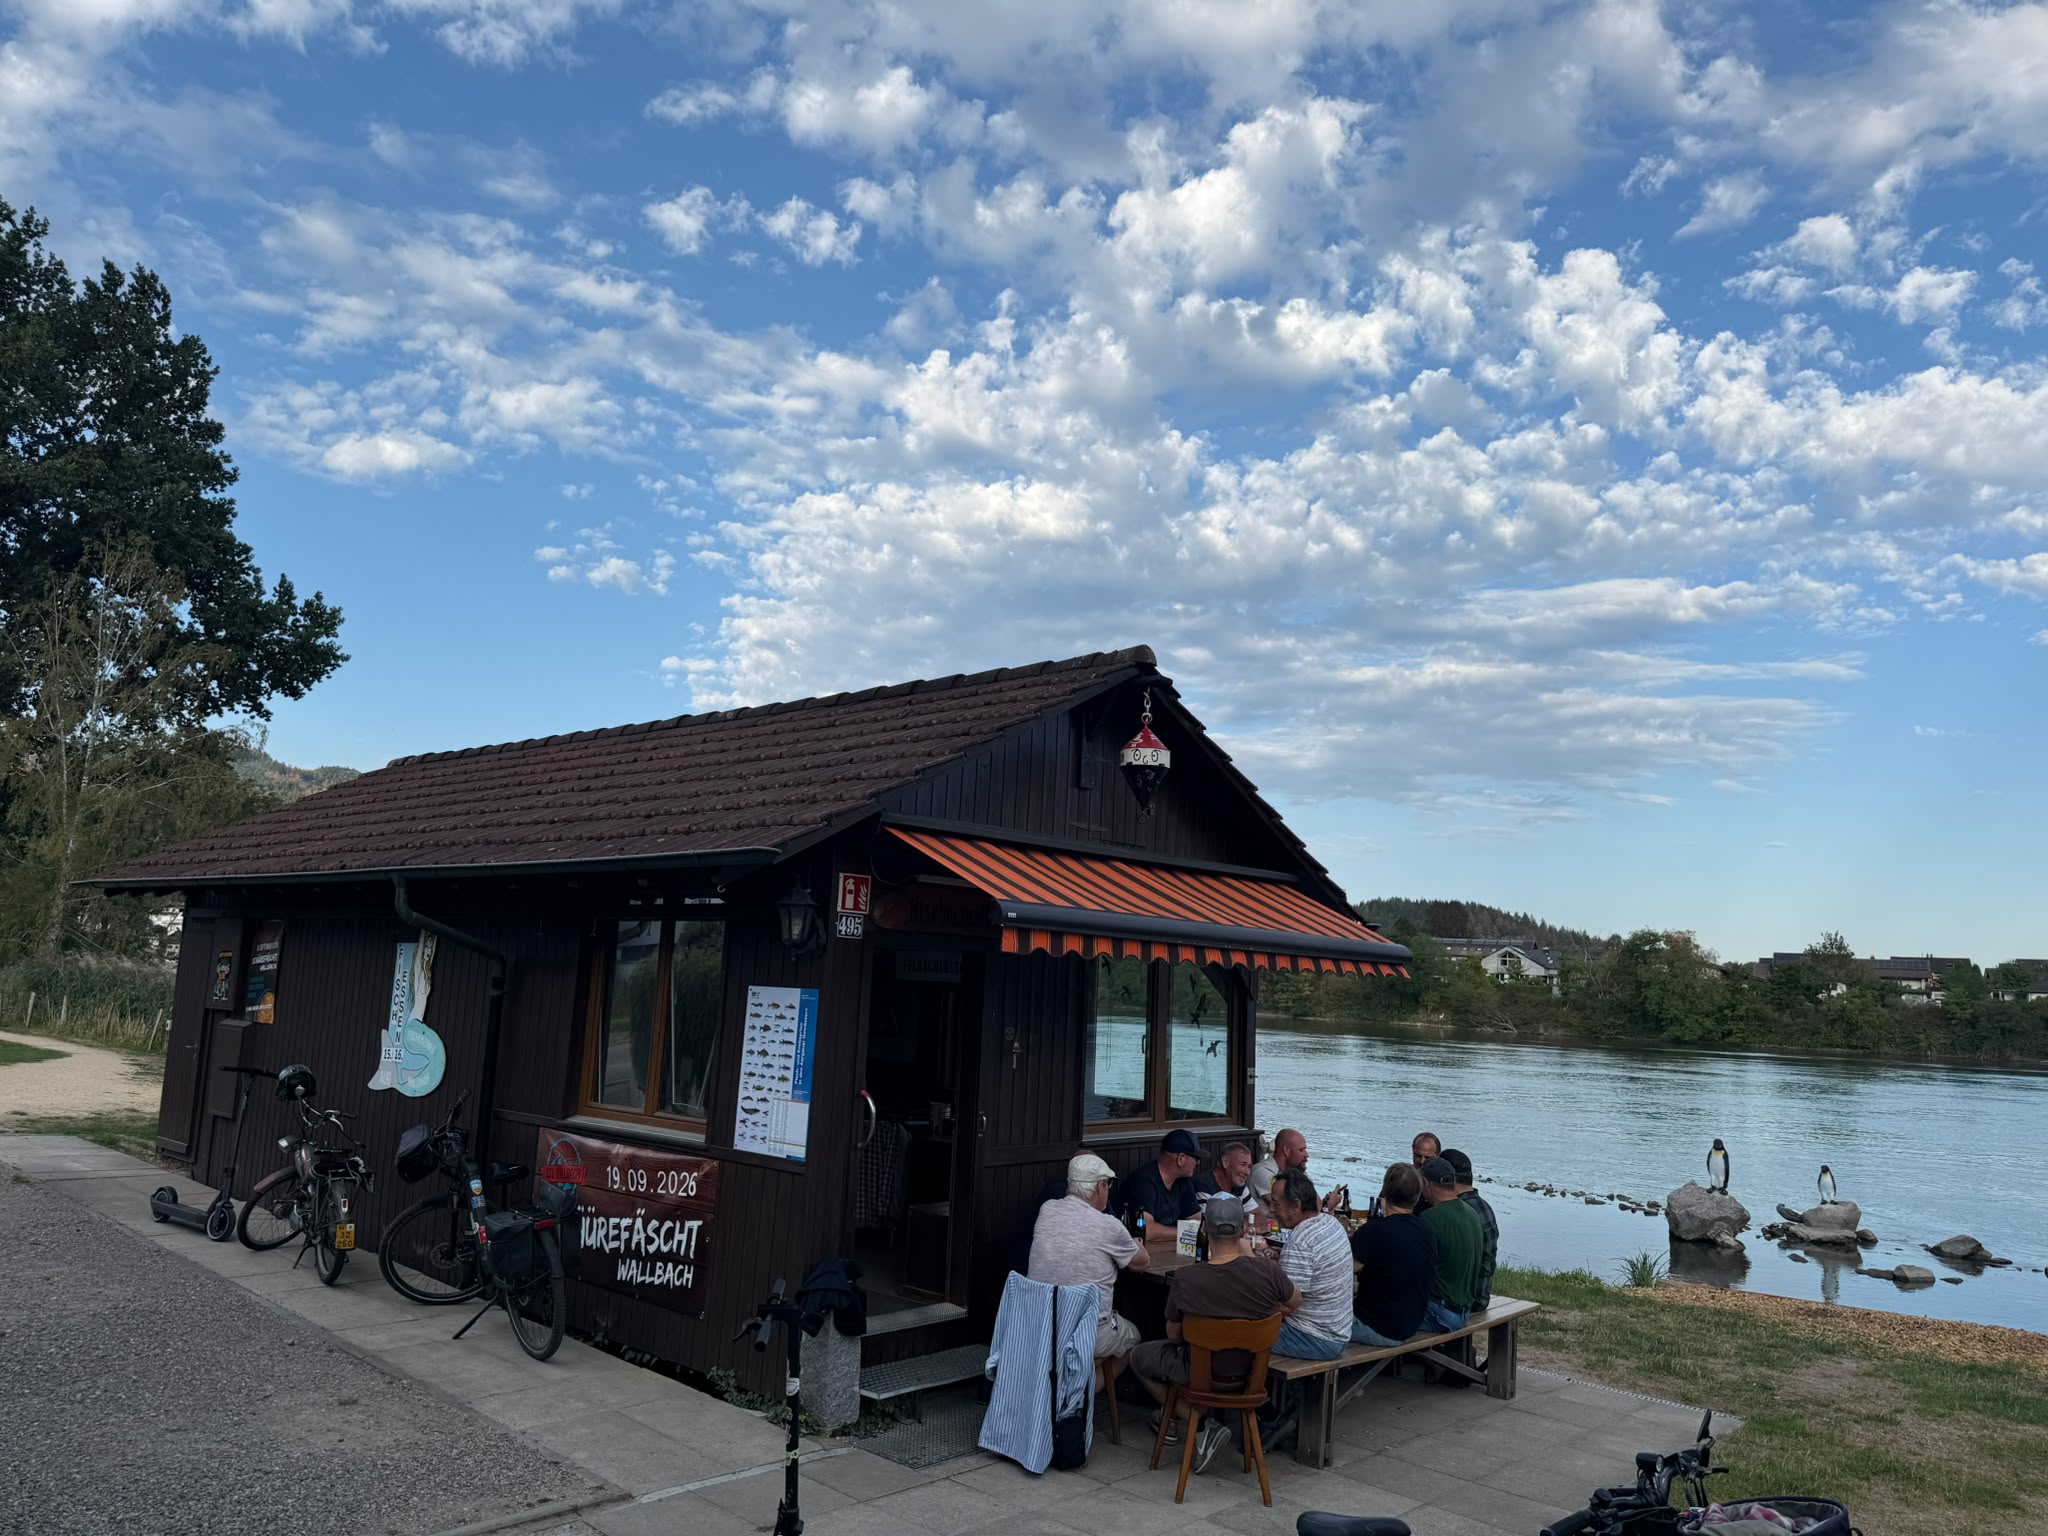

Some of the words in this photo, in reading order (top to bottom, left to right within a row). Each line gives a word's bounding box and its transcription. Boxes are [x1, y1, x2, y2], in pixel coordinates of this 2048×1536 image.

[838, 915, 863, 937] 495
[391, 947, 404, 1021] FISCH
[395, 971, 408, 1043] ESSEN
[383, 1049, 393, 1060] 15.
[394, 1049, 404, 1061] 16.
[606, 1165, 698, 1197] 19.09.2026
[616, 1258, 695, 1290] WALLBACH
